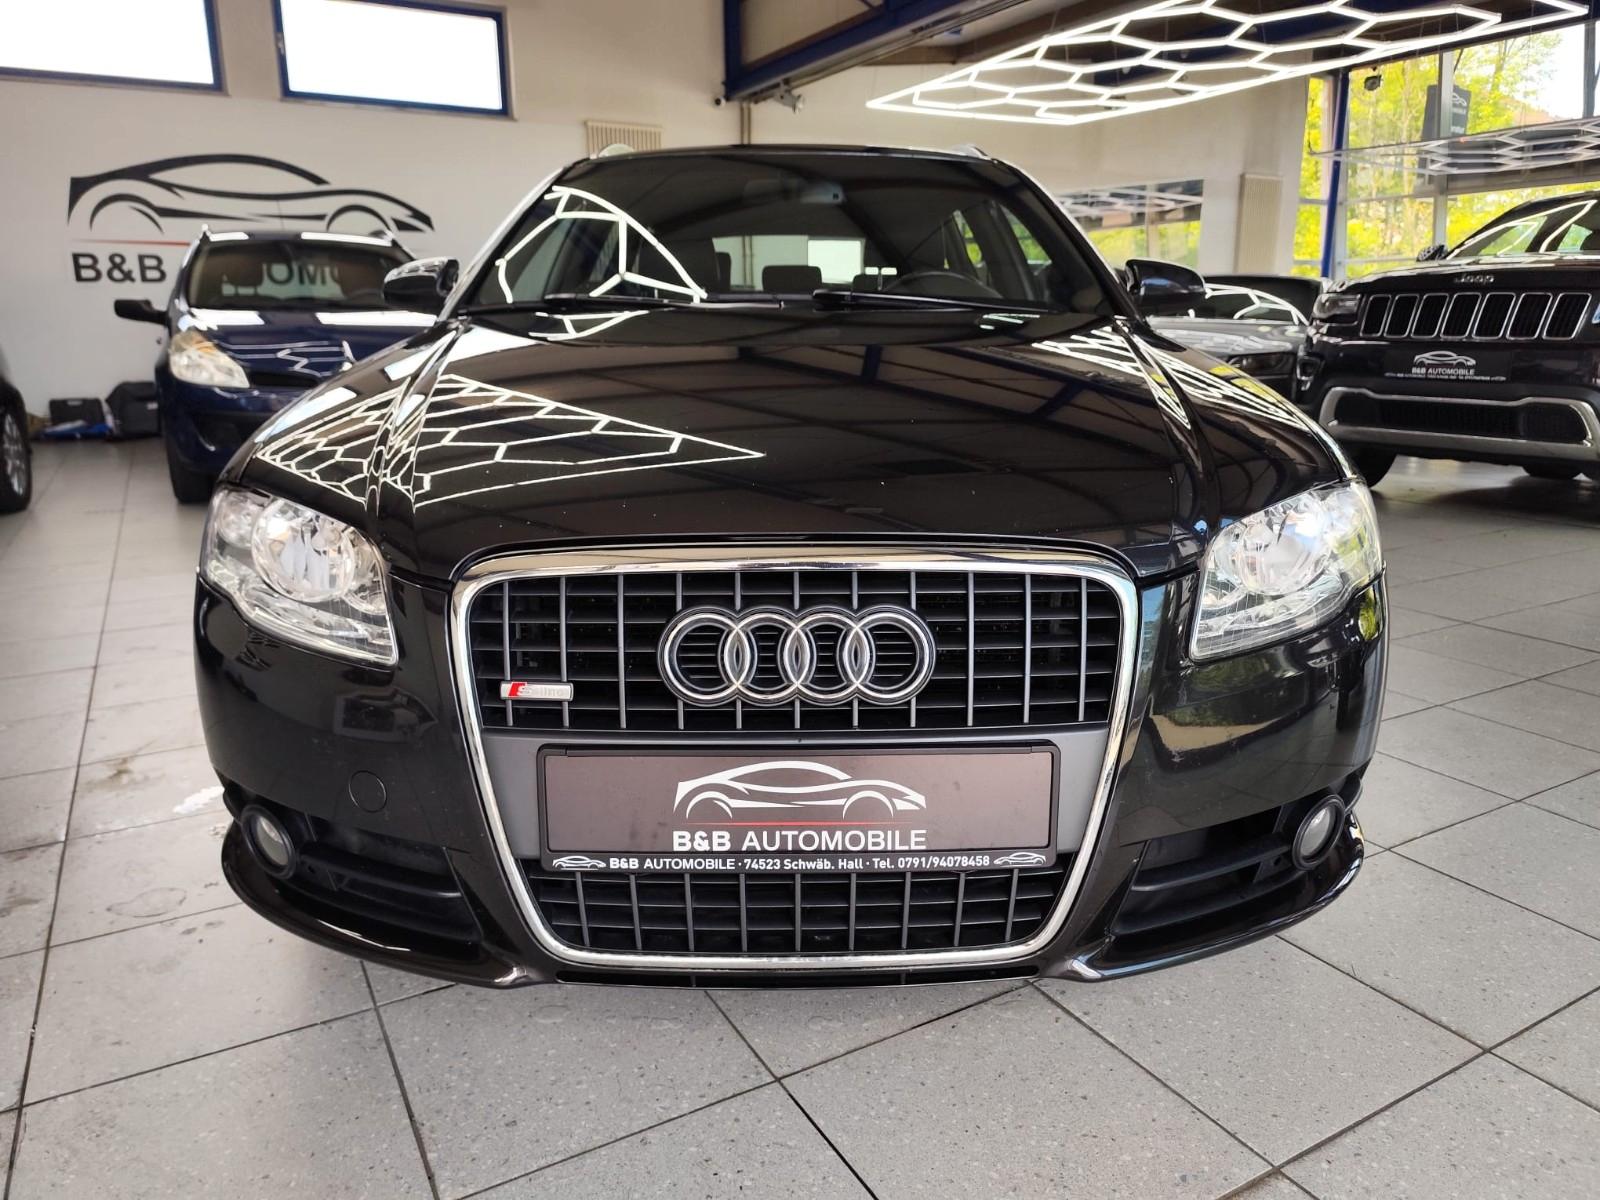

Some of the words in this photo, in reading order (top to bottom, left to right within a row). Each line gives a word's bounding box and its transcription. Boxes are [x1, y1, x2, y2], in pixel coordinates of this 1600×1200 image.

[72, 253, 167, 283] B&B
[1427, 367, 1475, 376] AUTOMOBILE
[672, 830, 731, 851] B&B
[741, 829, 927, 851] AUTOMOBILE
[609, 857, 639, 869] B&B
[643, 858, 735, 870] AUTOMOBILE
[743, 857, 781, 870] 74523
[783, 856, 835, 870] Schwäb.
[838, 857, 863, 870] Hall
[872, 857, 895, 869] Tel.
[897, 855, 990, 869] 0791/94078458
